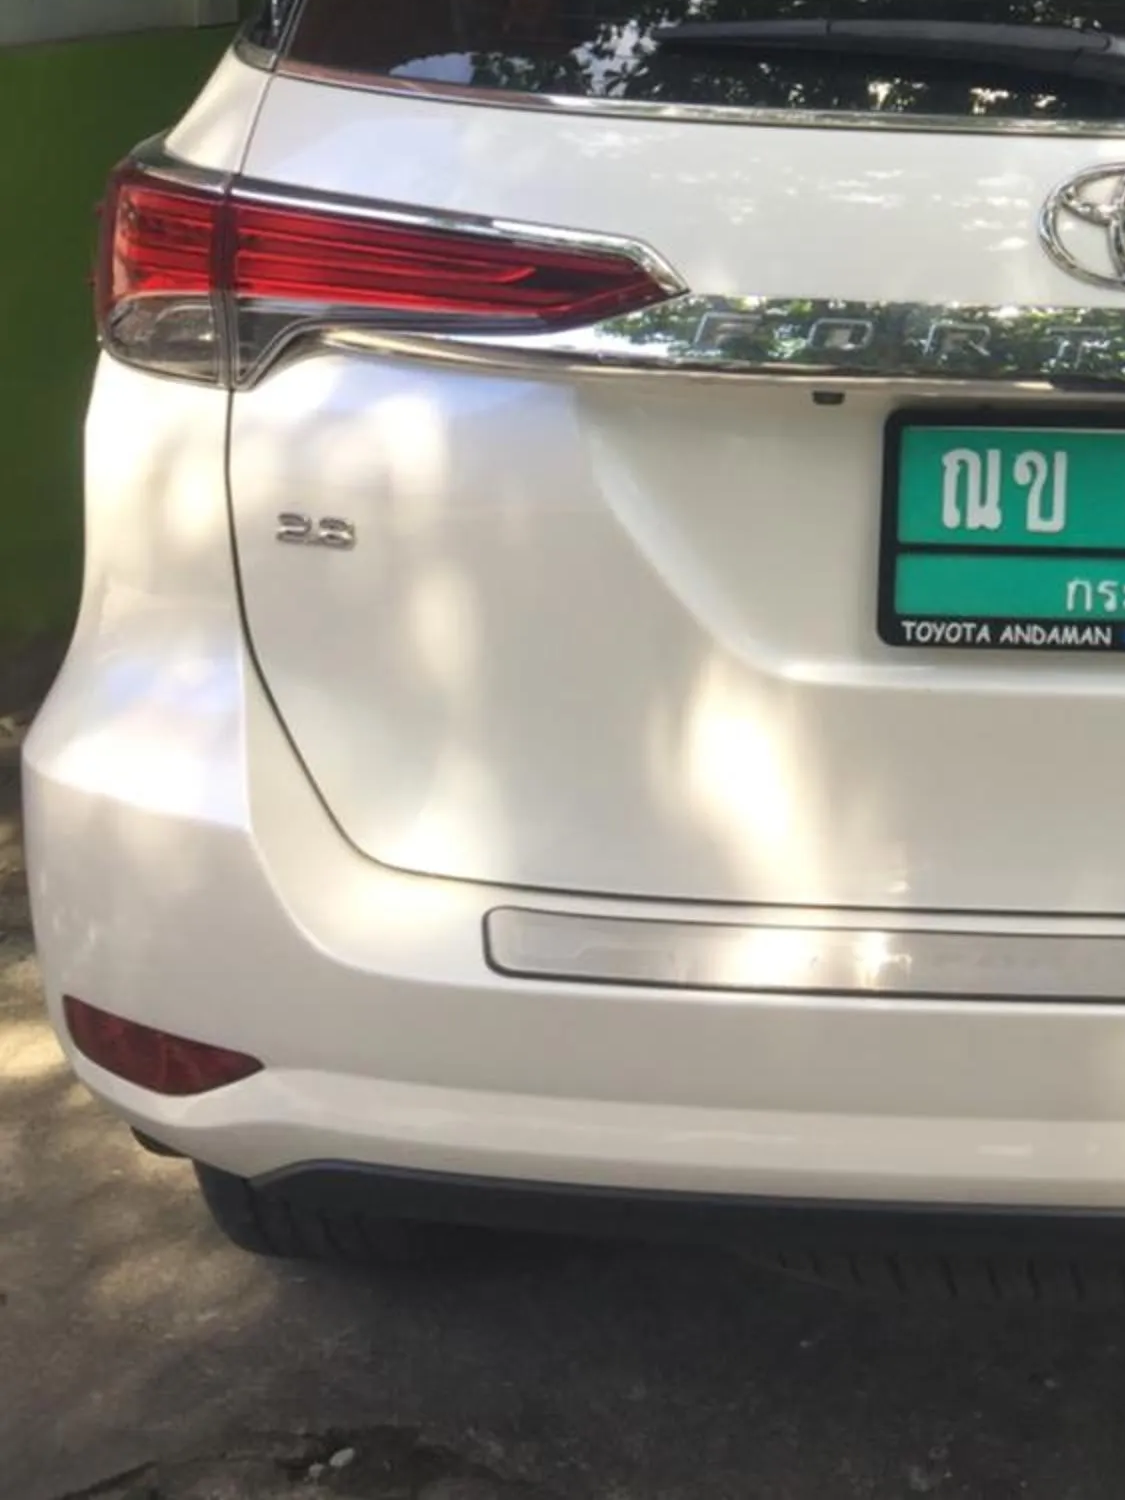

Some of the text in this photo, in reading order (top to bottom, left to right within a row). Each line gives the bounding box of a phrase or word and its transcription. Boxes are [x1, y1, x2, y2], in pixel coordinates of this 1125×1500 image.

[940, 447, 1068, 533] ณข
[902, 621, 991, 643] TOYOTA
[1000, 623, 1112, 646] ANDAMAN
